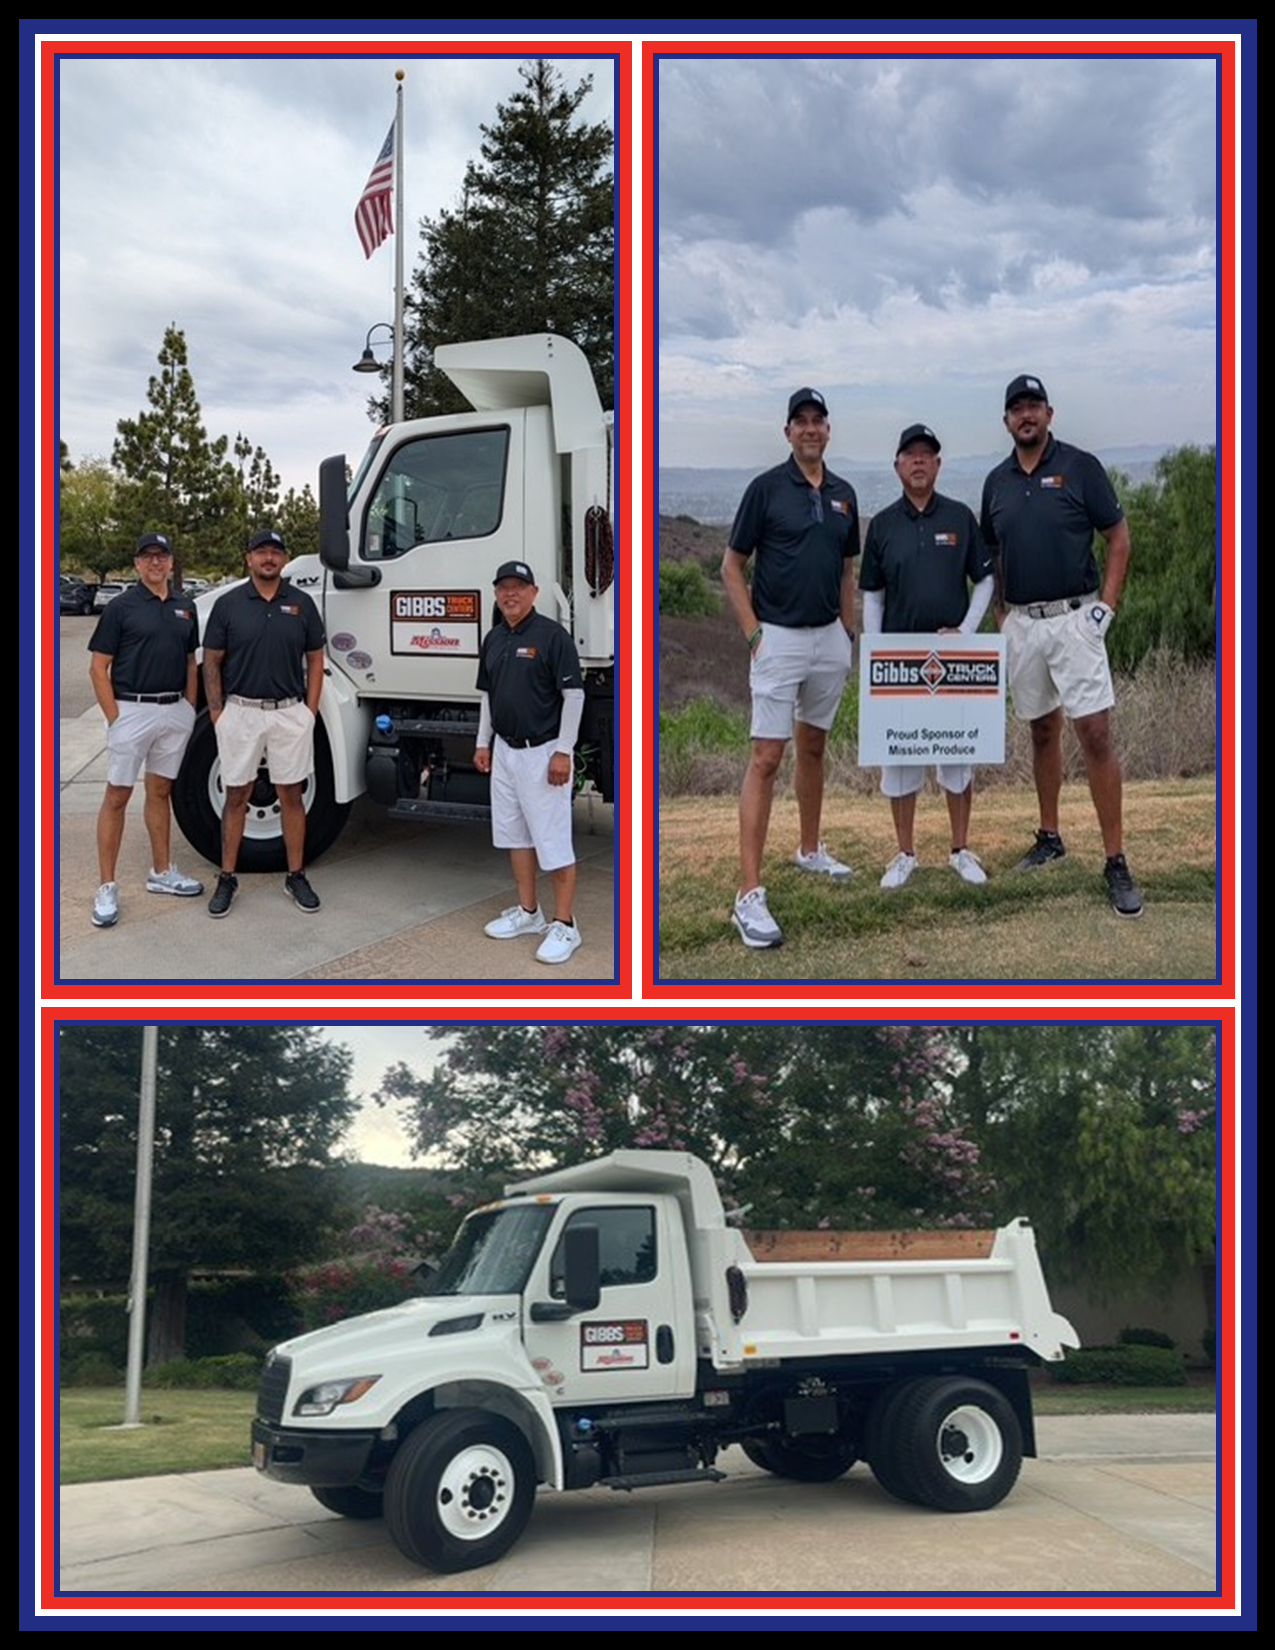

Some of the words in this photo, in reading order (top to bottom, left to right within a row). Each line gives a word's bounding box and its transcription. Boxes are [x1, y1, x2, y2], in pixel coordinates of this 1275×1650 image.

[396, 597, 446, 617] GIBBS
[872, 661, 919, 684] Gibbs
[946, 663, 996, 673] TRUCK
[946, 673, 997, 683] CENTERS
[886, 728, 919, 740] Proud
[921, 728, 966, 741] Sponsor
[967, 728, 979, 740] of
[888, 744, 930, 756] Mission
[932, 744, 976, 756] Produce
[585, 1326, 625, 1342] GIBBS
